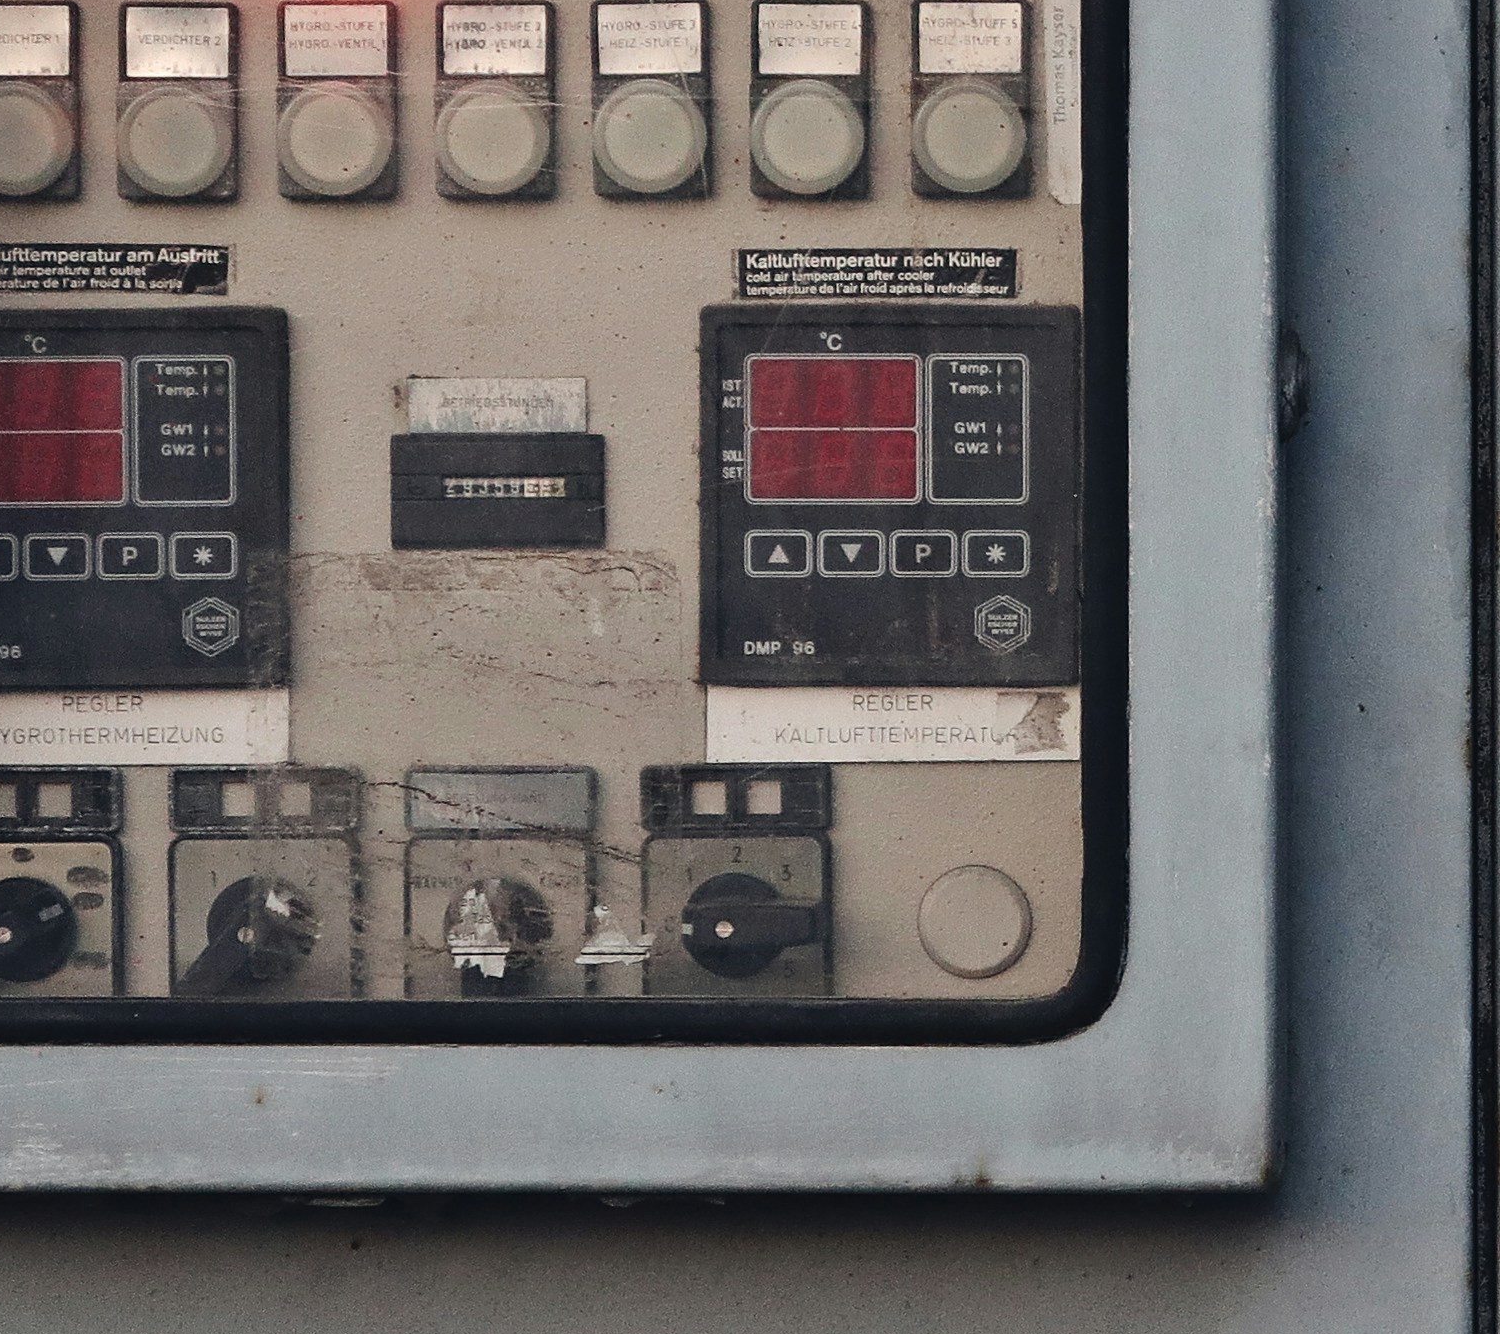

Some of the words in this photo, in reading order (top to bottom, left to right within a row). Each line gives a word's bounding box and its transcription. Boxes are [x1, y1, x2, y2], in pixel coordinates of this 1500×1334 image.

[138, 34, 211, 46] VERDICHTER
[214, 35, 221, 46] 2
[1053, 68, 1065, 125] Thomas
[126, 249, 153, 261] am
[157, 248, 220, 265] Austritt
[746, 254, 898, 270] Kaltlufttemperatur
[903, 252, 944, 267] nach
[948, 252, 1002, 267] Kühler
[13, 266, 89, 278] temperature
[93, 266, 108, 276] at
[110, 266, 146, 276] outlet
[746, 272, 771, 283] cold
[774, 272, 788, 282] air
[866, 270, 894, 282] after
[898, 270, 935, 282] cooler
[819, 283, 834, 294] de
[860, 283, 887, 294] froid
[889, 282, 922, 296] après
[924, 282, 935, 294] le
[936, 282, 1009, 295] refroidisseur
[24, 334, 47, 354] °C
[820, 331, 842, 351] °C
[154, 364, 198, 378] Temp.
[949, 362, 992, 376] Temp.
[156, 384, 199, 398] Temp.
[949, 382, 992, 396] Temp.
[160, 423, 194, 436] GW1
[954, 422, 986, 434] GW1
[161, 444, 195, 456] GW2
[954, 442, 989, 454] GW2
[722, 450, 744, 461] SOLL
[722, 467, 743, 479] SET
[122, 546, 138, 566] P
[915, 544, 931, 563] P
[0, 645, 21, 659] 96
[744, 641, 781, 655] DMP
[792, 641, 815, 655] 96
[62, 695, 143, 713] REGLER
[853, 694, 934, 712] REGLER
